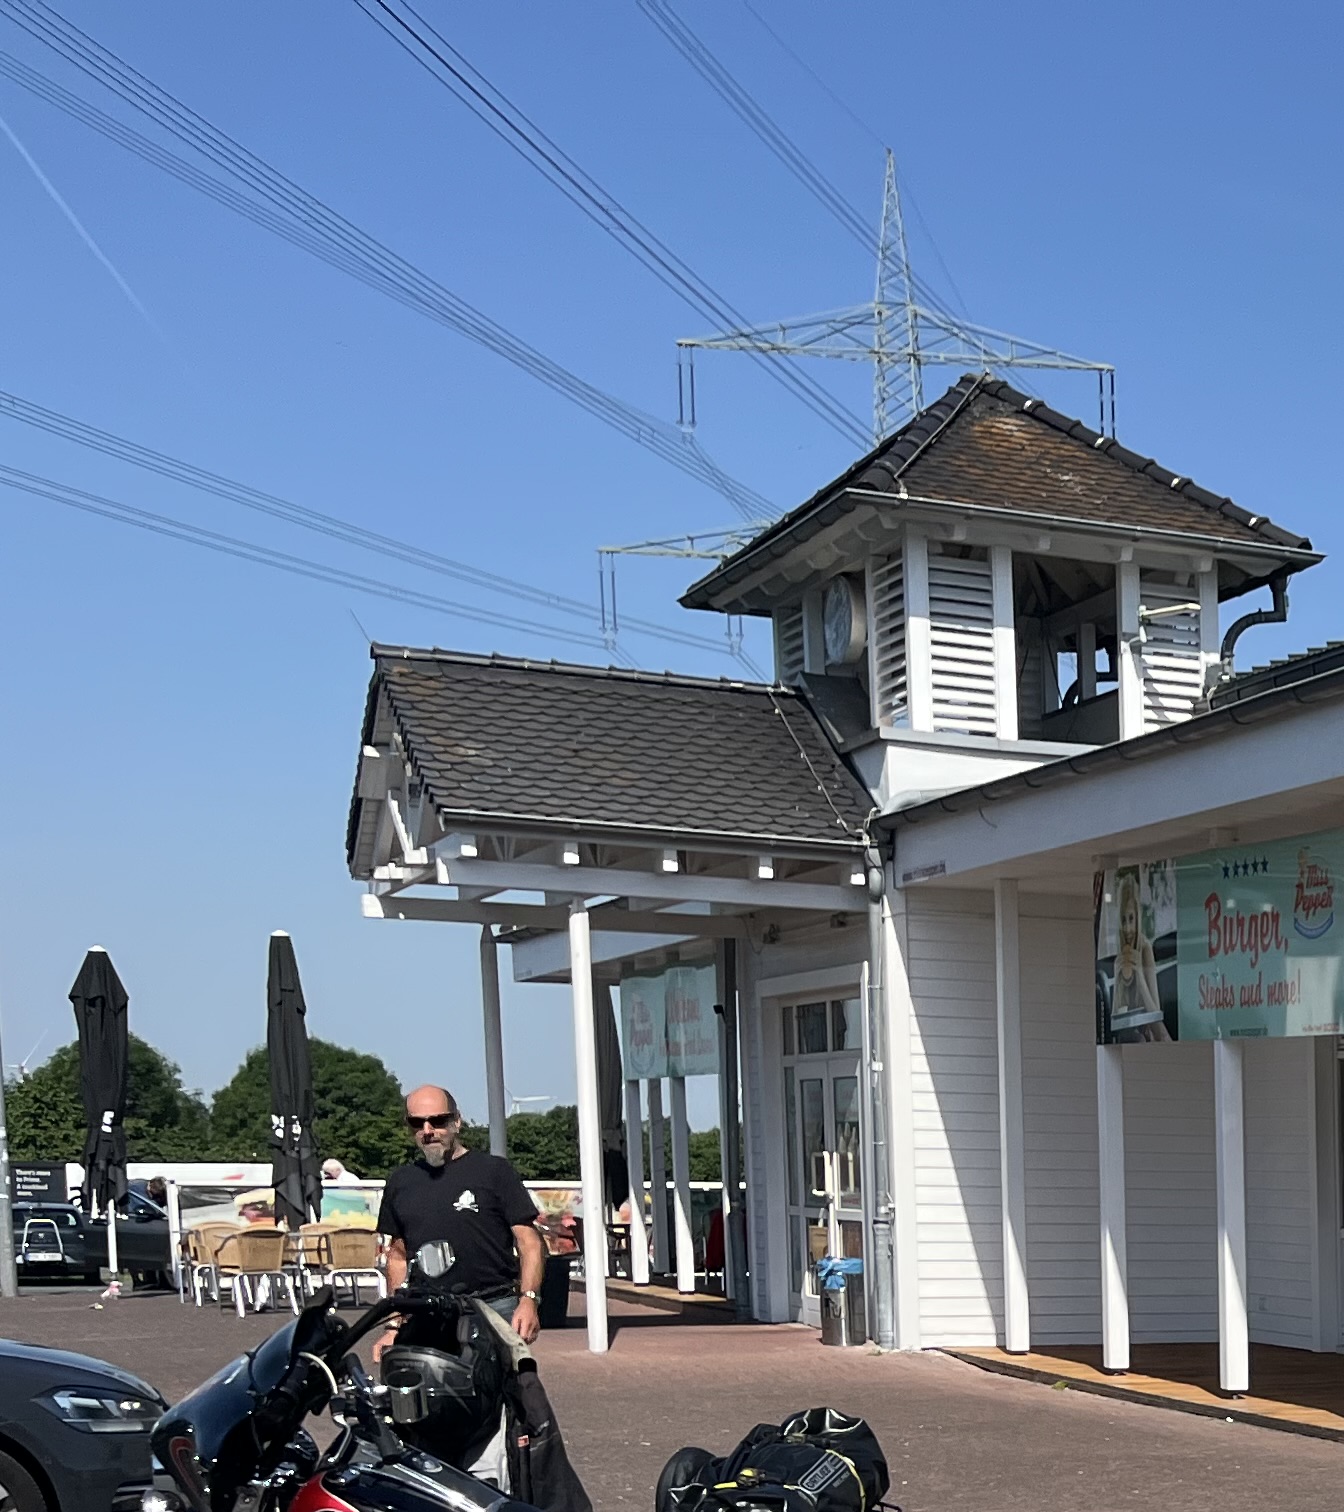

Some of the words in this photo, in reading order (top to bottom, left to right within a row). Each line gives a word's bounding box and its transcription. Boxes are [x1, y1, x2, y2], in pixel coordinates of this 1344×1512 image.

[1306, 864, 1329, 888] Miss
[1204, 891, 1289, 968] Burger,
[1198, 973, 1236, 1010] Steaks
[1239, 972, 1263, 1008] and
[1267, 968, 1302, 1008] more!
